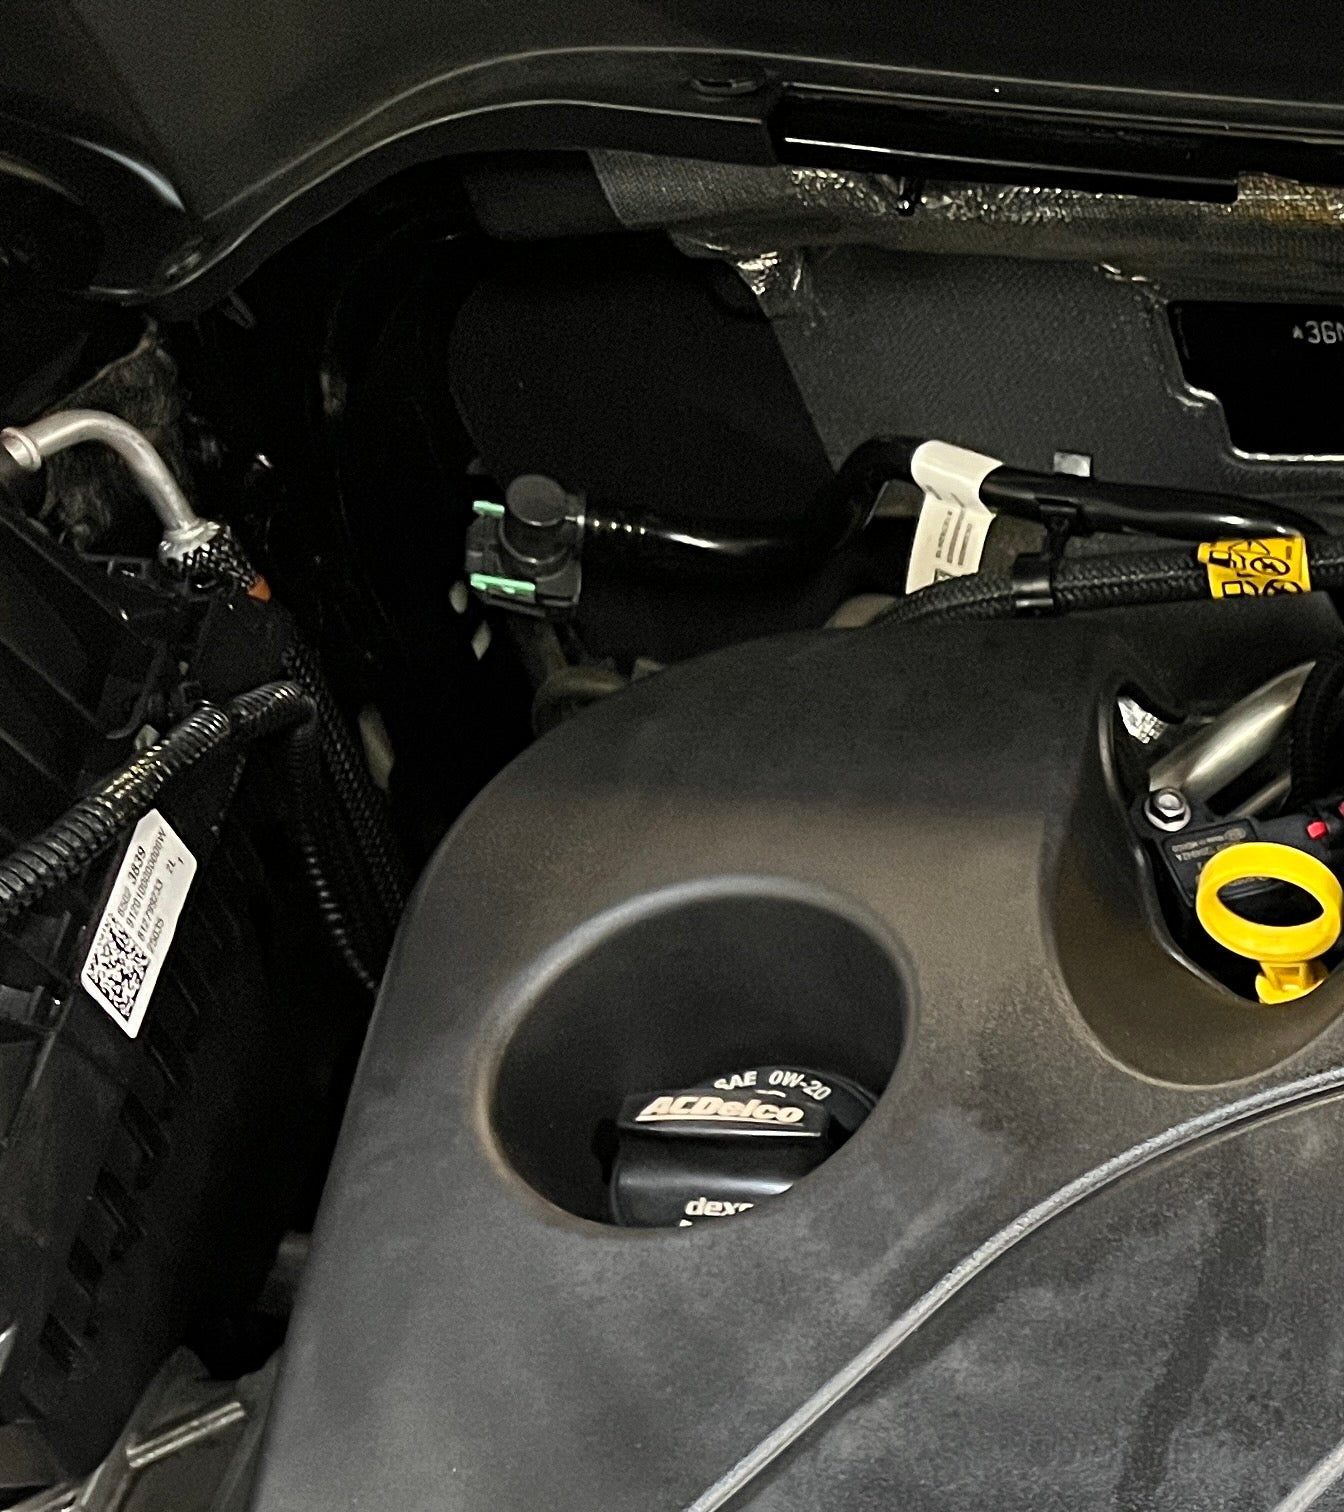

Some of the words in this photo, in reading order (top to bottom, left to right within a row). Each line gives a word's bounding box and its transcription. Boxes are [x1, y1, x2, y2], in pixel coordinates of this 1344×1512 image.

[127, 844, 146, 886] 3839
[713, 1070, 758, 1090] SAE
[768, 1070, 832, 1101] 0W-20
[636, 1095, 805, 1126] ACDelco
